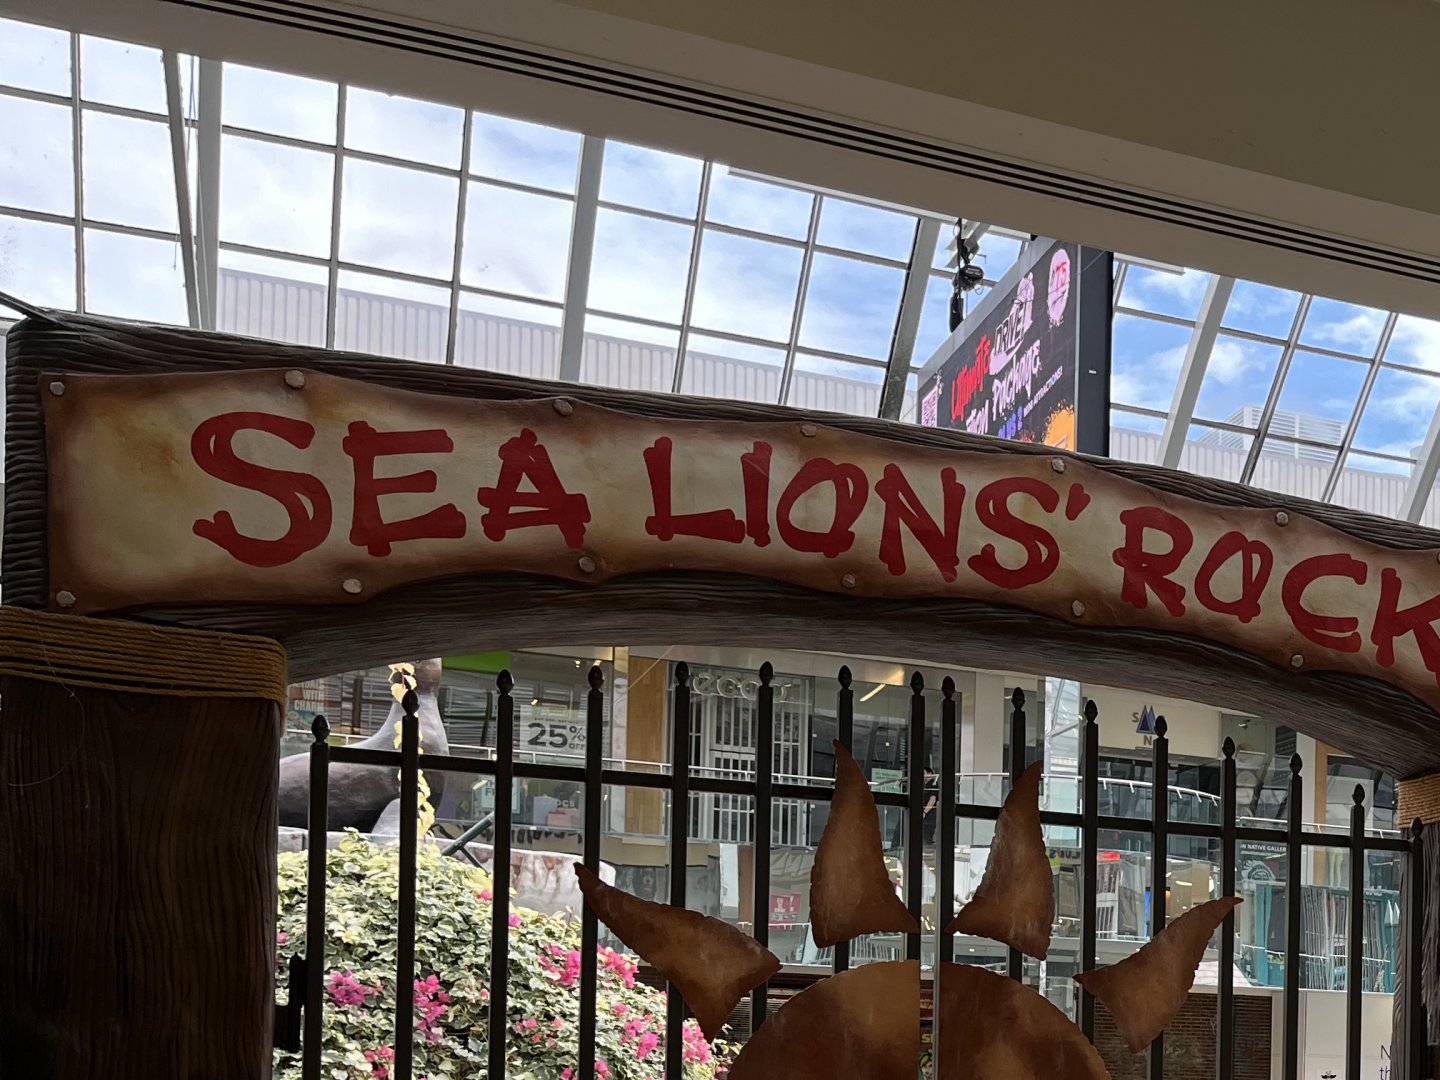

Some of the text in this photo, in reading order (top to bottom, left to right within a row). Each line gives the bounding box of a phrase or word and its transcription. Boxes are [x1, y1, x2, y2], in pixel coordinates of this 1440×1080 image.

[191, 411, 591, 567] SEA
[644, 437, 1091, 590] LIONS'
[303, 689, 324, 700] WITH
[294, 700, 324, 712] CHARM
